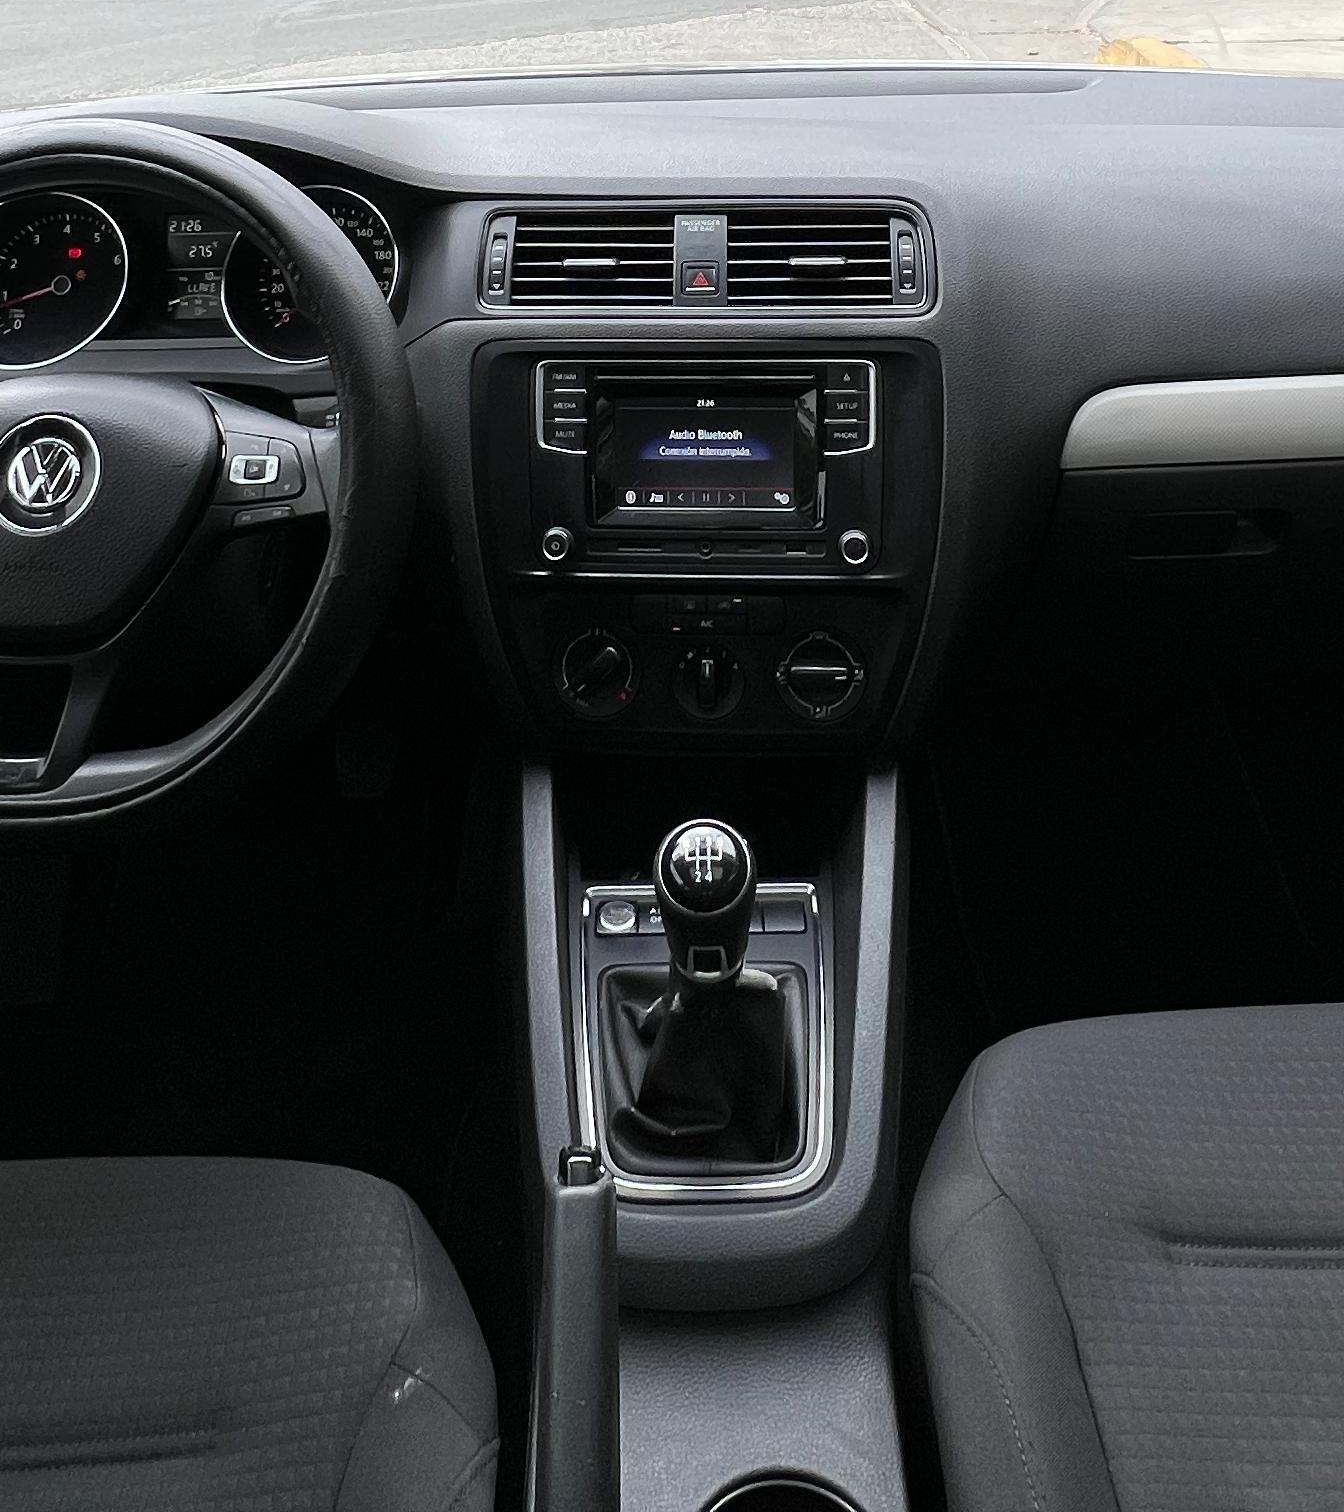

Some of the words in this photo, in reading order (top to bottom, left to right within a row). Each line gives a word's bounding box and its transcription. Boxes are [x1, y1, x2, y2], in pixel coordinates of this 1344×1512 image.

[356, 229, 374, 238] 140
[375, 251, 393, 260] 180
[271, 283, 285, 294] 20
[668, 429, 696, 441] Audio
[697, 429, 744, 441] Bluetooth
